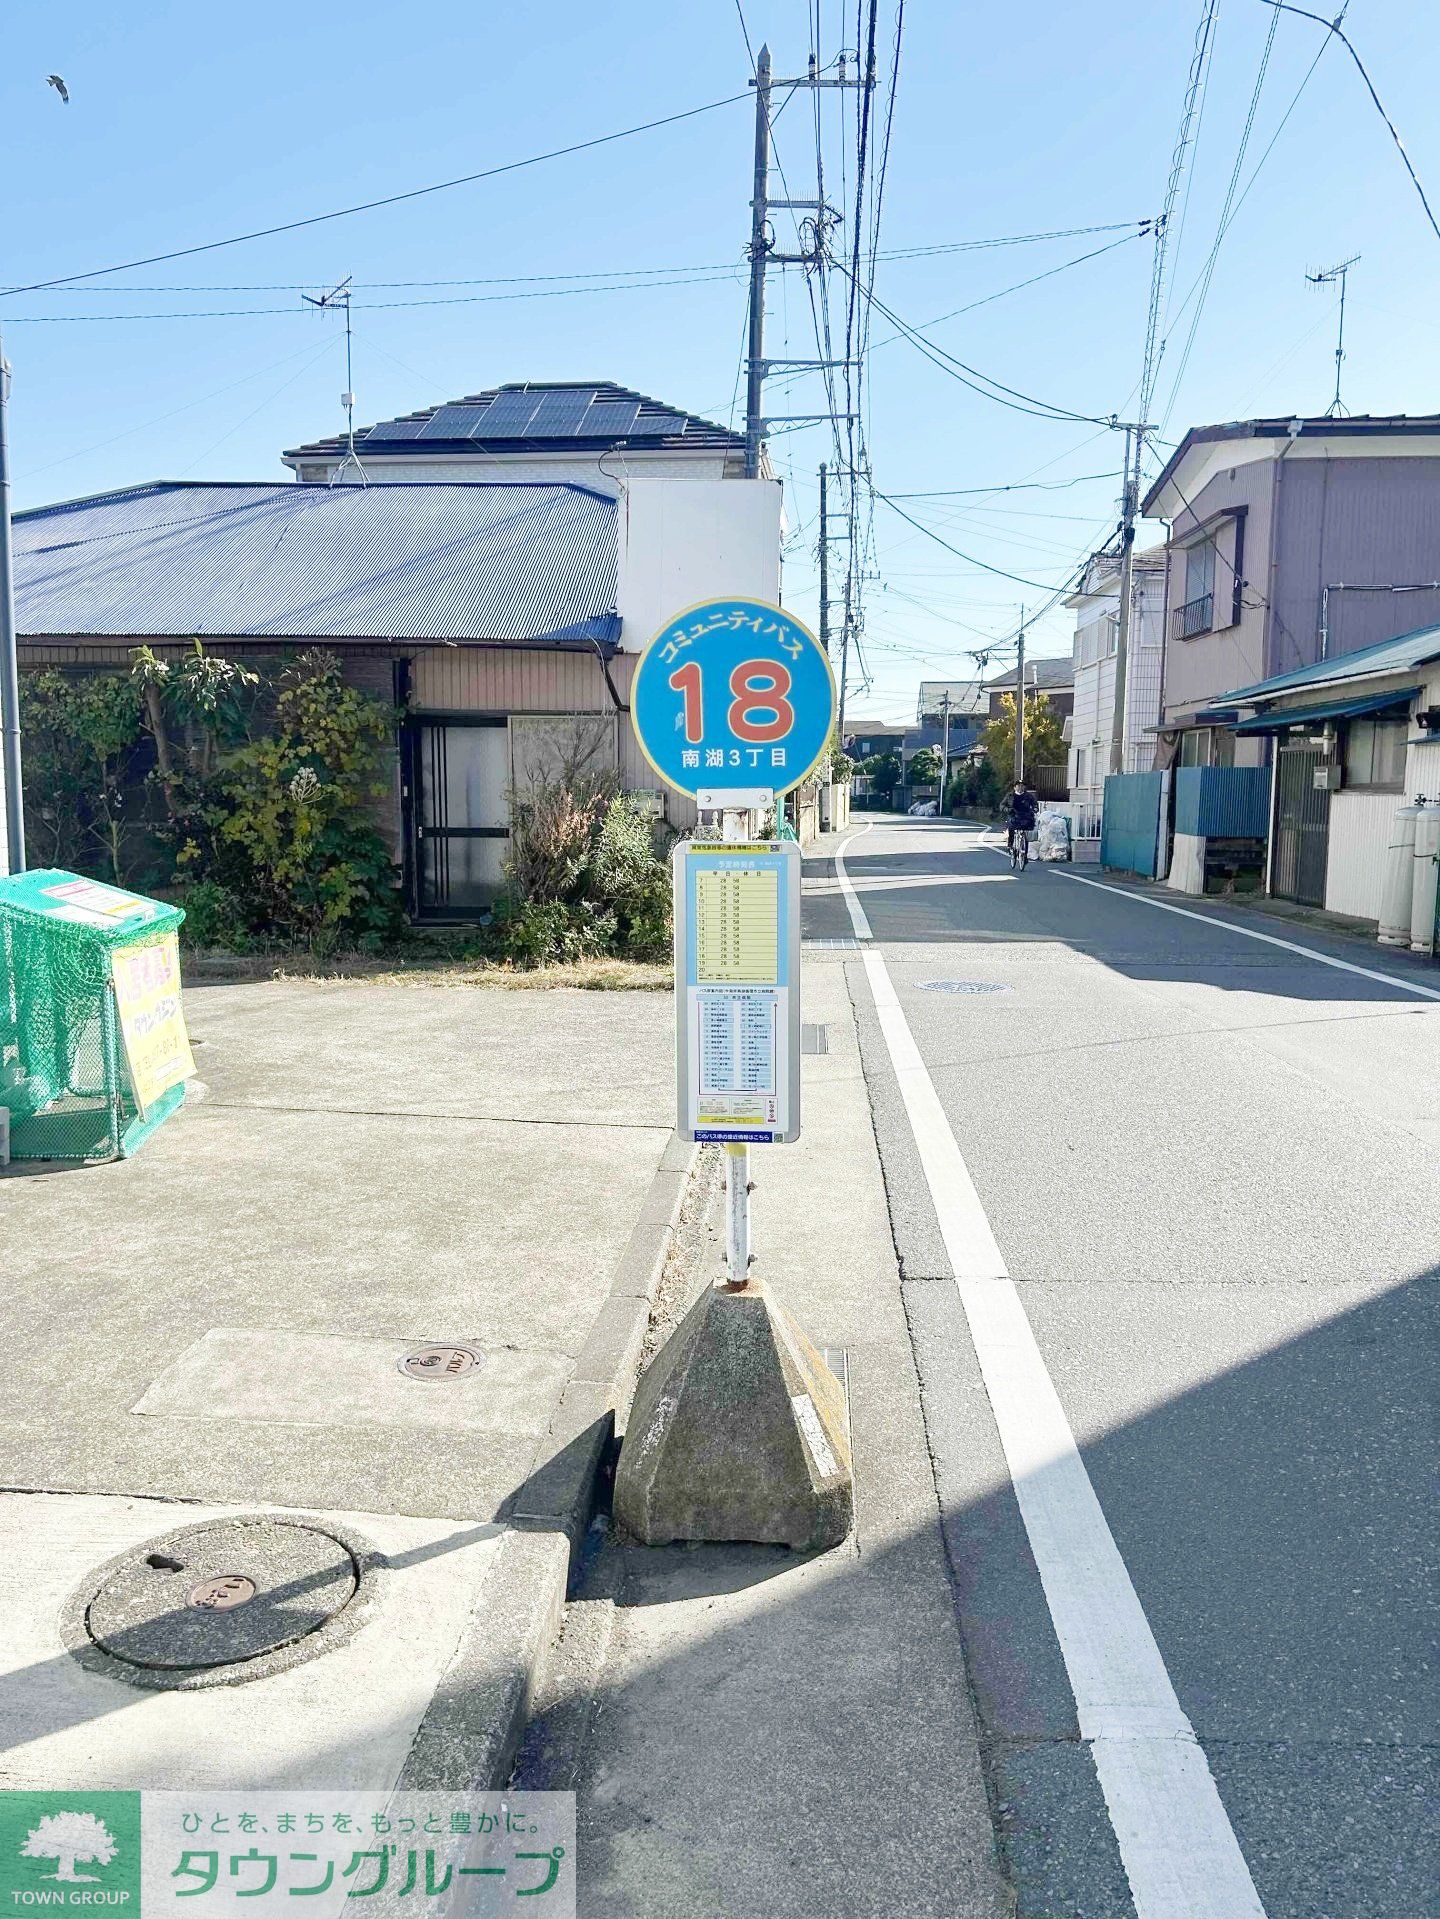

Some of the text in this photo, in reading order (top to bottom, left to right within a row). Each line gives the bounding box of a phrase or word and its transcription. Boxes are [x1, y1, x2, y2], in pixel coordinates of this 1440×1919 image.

[658, 610, 805, 664] コミュニティバス
[668, 658, 795, 744] 18
[681, 747, 787, 768] 南湖3丁目
